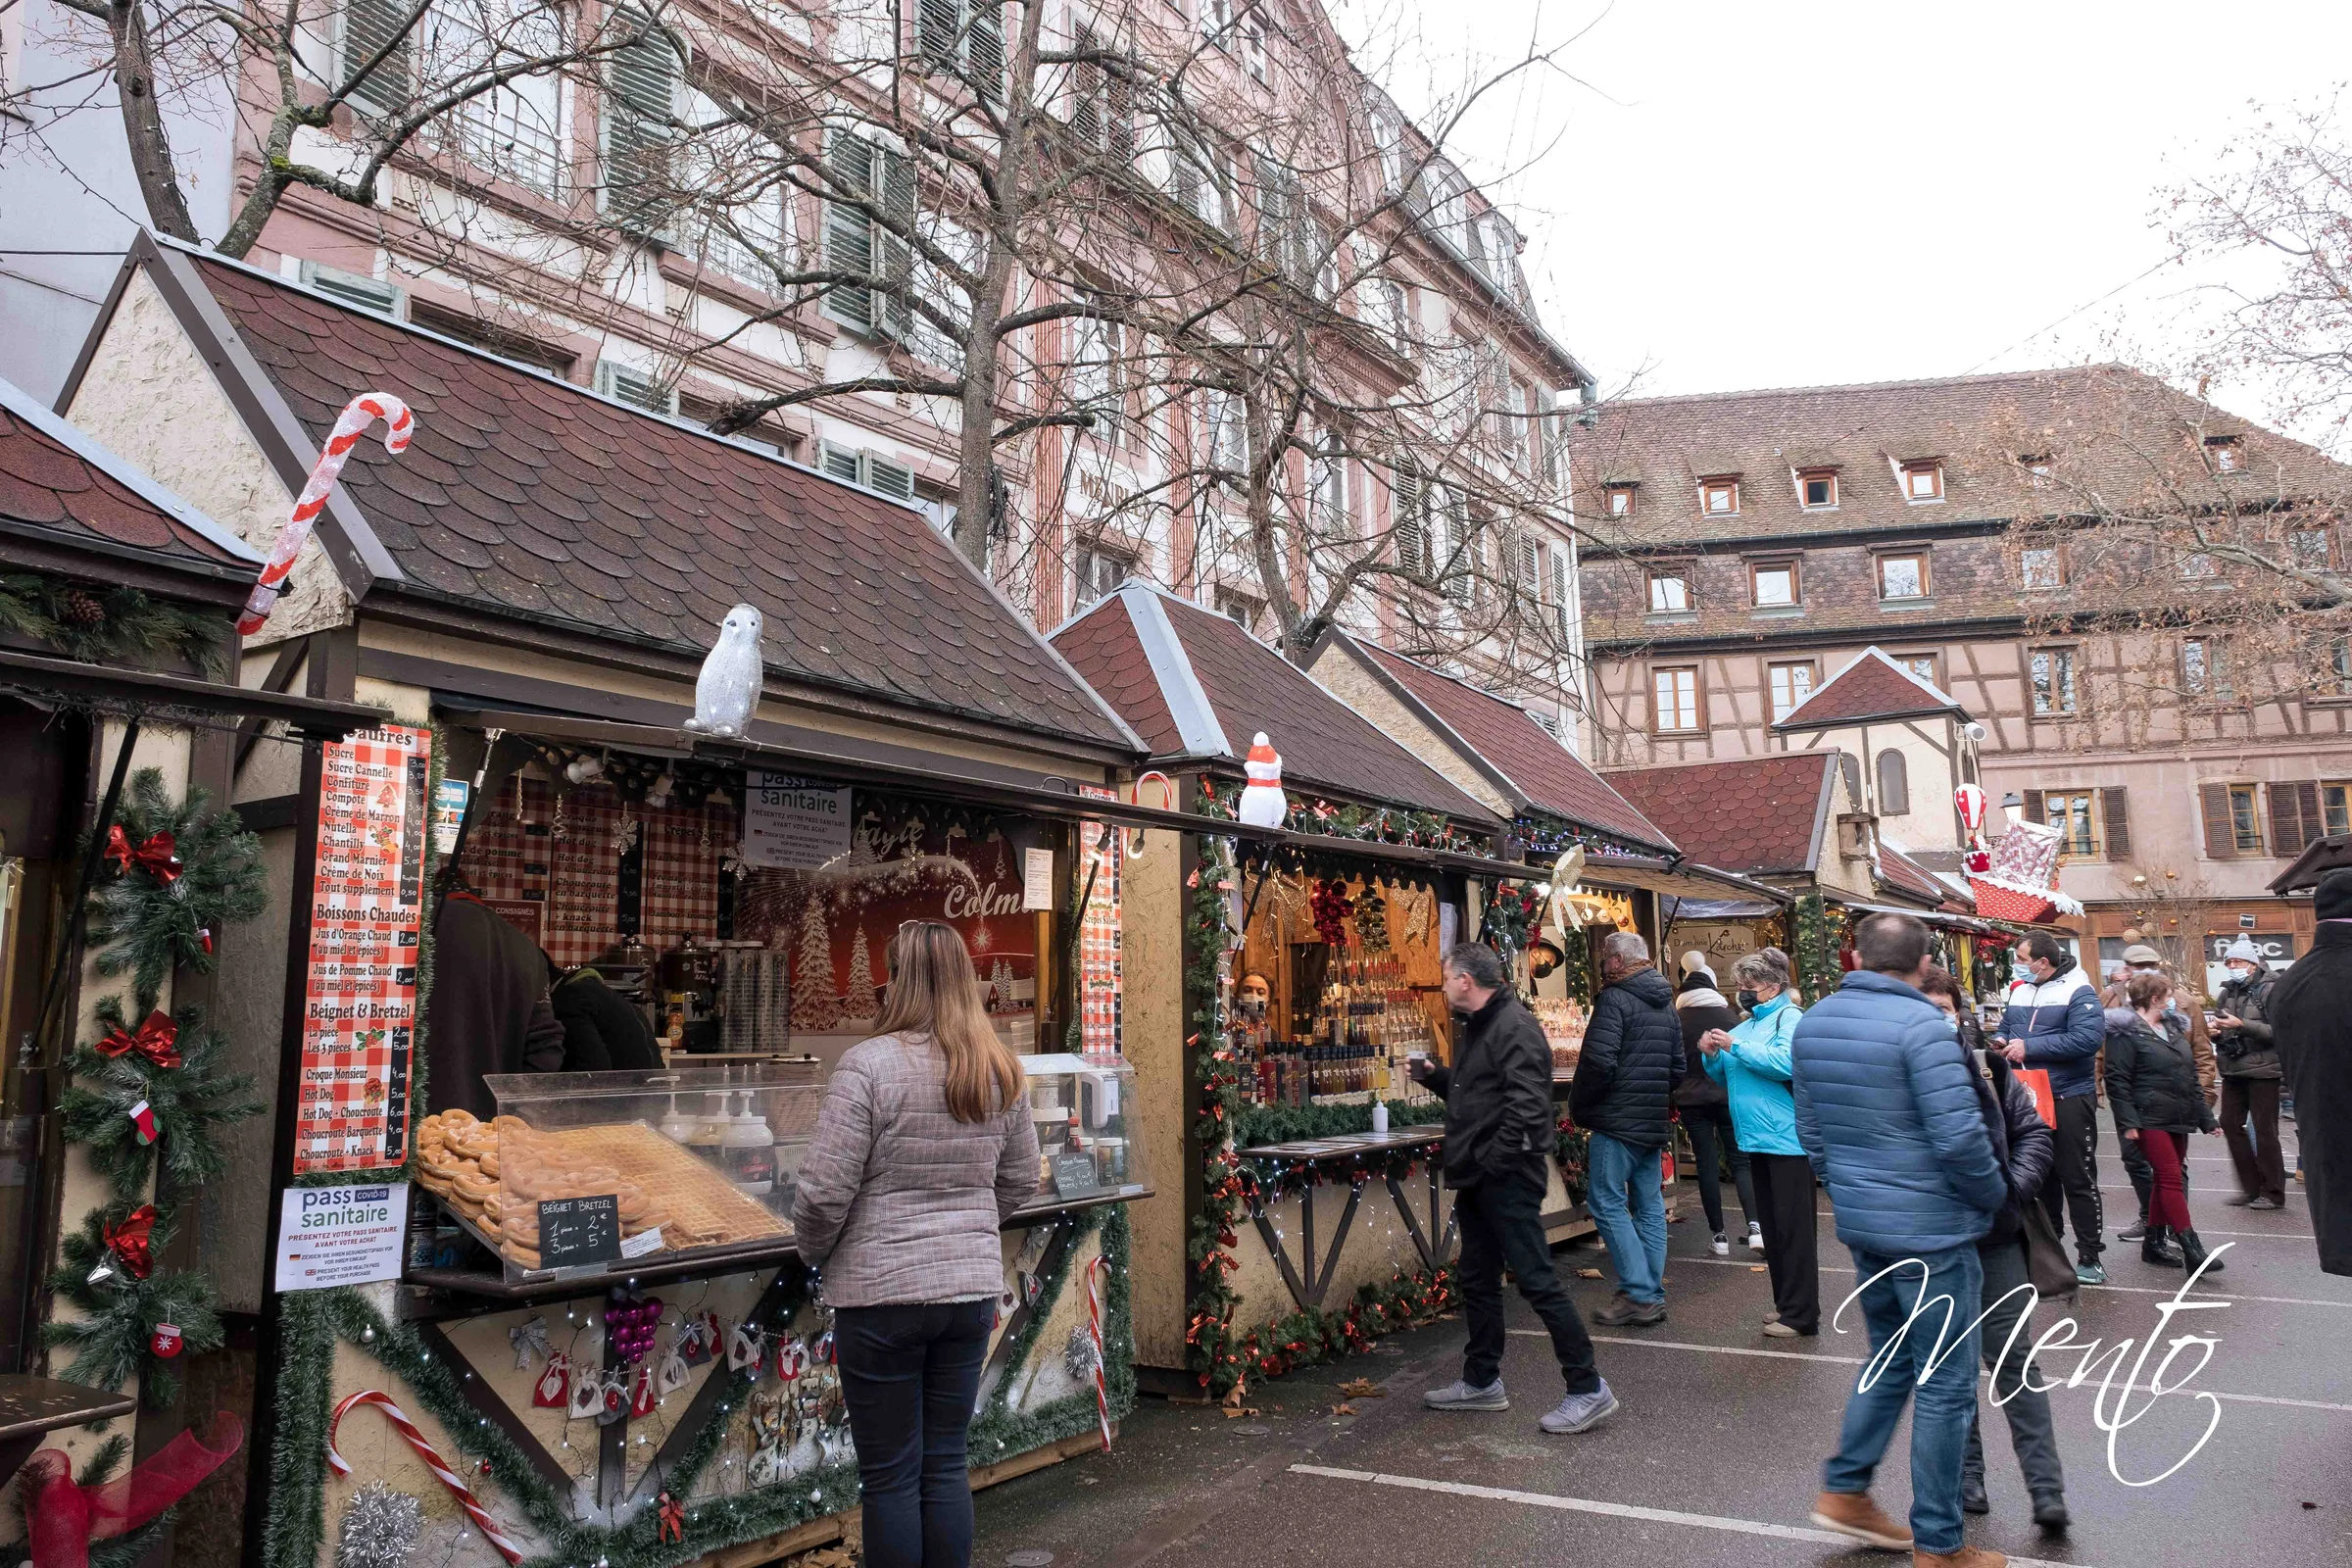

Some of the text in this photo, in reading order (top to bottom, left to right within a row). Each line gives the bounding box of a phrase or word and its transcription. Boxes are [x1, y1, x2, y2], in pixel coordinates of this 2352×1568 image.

[346, 728, 412, 746] aufres
[329, 746, 354, 759] Sucre
[328, 760, 353, 773] Sucre
[356, 764, 393, 778] Cannelle
[327, 775, 369, 790] Confiture
[326, 790, 365, 806] Compote
[760, 789, 836, 813] sanitaire
[324, 806, 353, 818] Crème
[356, 809, 367, 819] de
[368, 809, 400, 822] Marron
[324, 820, 357, 833] Nutella
[819, 818, 846, 827] SANITAIRE
[323, 835, 365, 851] Chantilly
[322, 851, 350, 862] Grand
[353, 854, 387, 865] Marnier
[470, 846, 522, 858] de pomme
[557, 854, 595, 864] Hot dog
[320, 865, 349, 878] Crème
[352, 868, 363, 879] de
[365, 868, 385, 880] Noix
[564, 864, 616, 876] Choucroute
[319, 881, 342, 893] Tout
[343, 883, 395, 896] supplément
[557, 878, 612, 889] Choucroute
[569, 890, 615, 900] barquette
[944, 881, 1034, 918] Colm
[317, 904, 416, 923] Boissons Chaudes
[555, 903, 611, 912] Choucroute
[563, 913, 592, 922] knack
[567, 923, 614, 933] barquette
[317, 928, 329, 939] Jus
[331, 928, 366, 943] d'Orange
[368, 929, 391, 941] Chaud
[329, 944, 347, 955] miel
[349, 946, 357, 955] et
[358, 945, 384, 958] épices)
[314, 965, 326, 975] Jus
[328, 964, 337, 975] de
[340, 965, 367, 976] Pomme
[368, 964, 392, 976] Chaud
[327, 980, 344, 990] miel
[345, 981, 353, 990] et
[355, 980, 380, 994] épices)
[310, 1003, 411, 1022] Beignet & Bretzel
[309, 1026, 318, 1037] La
[319, 1026, 339, 1039] pièce
[308, 1042, 319, 1053] Les
[321, 1043, 326, 1054] 3
[328, 1041, 351, 1055] pièces
[307, 1068, 333, 1083] Croque
[335, 1067, 368, 1079] Monsieur
[305, 1088, 318, 1100] Hot
[320, 1088, 334, 1102] Dog
[303, 1108, 317, 1120] Hot
[318, 1107, 333, 1121] Dog
[340, 1106, 382, 1118] Choucroute
[302, 1128, 345, 1140] Choucroute
[347, 1126, 382, 1139] Barquette
[300, 1149, 344, 1159] Choucroute
[351, 1145, 374, 1156] Knack
[303, 1190, 387, 1212] pass COVID-19
[541, 1200, 612, 1214] BEIGNET BRETZEL
[301, 1203, 388, 1228] sanitaire
[549, 1220, 559, 1237] 1
[550, 1239, 561, 1253] 3
